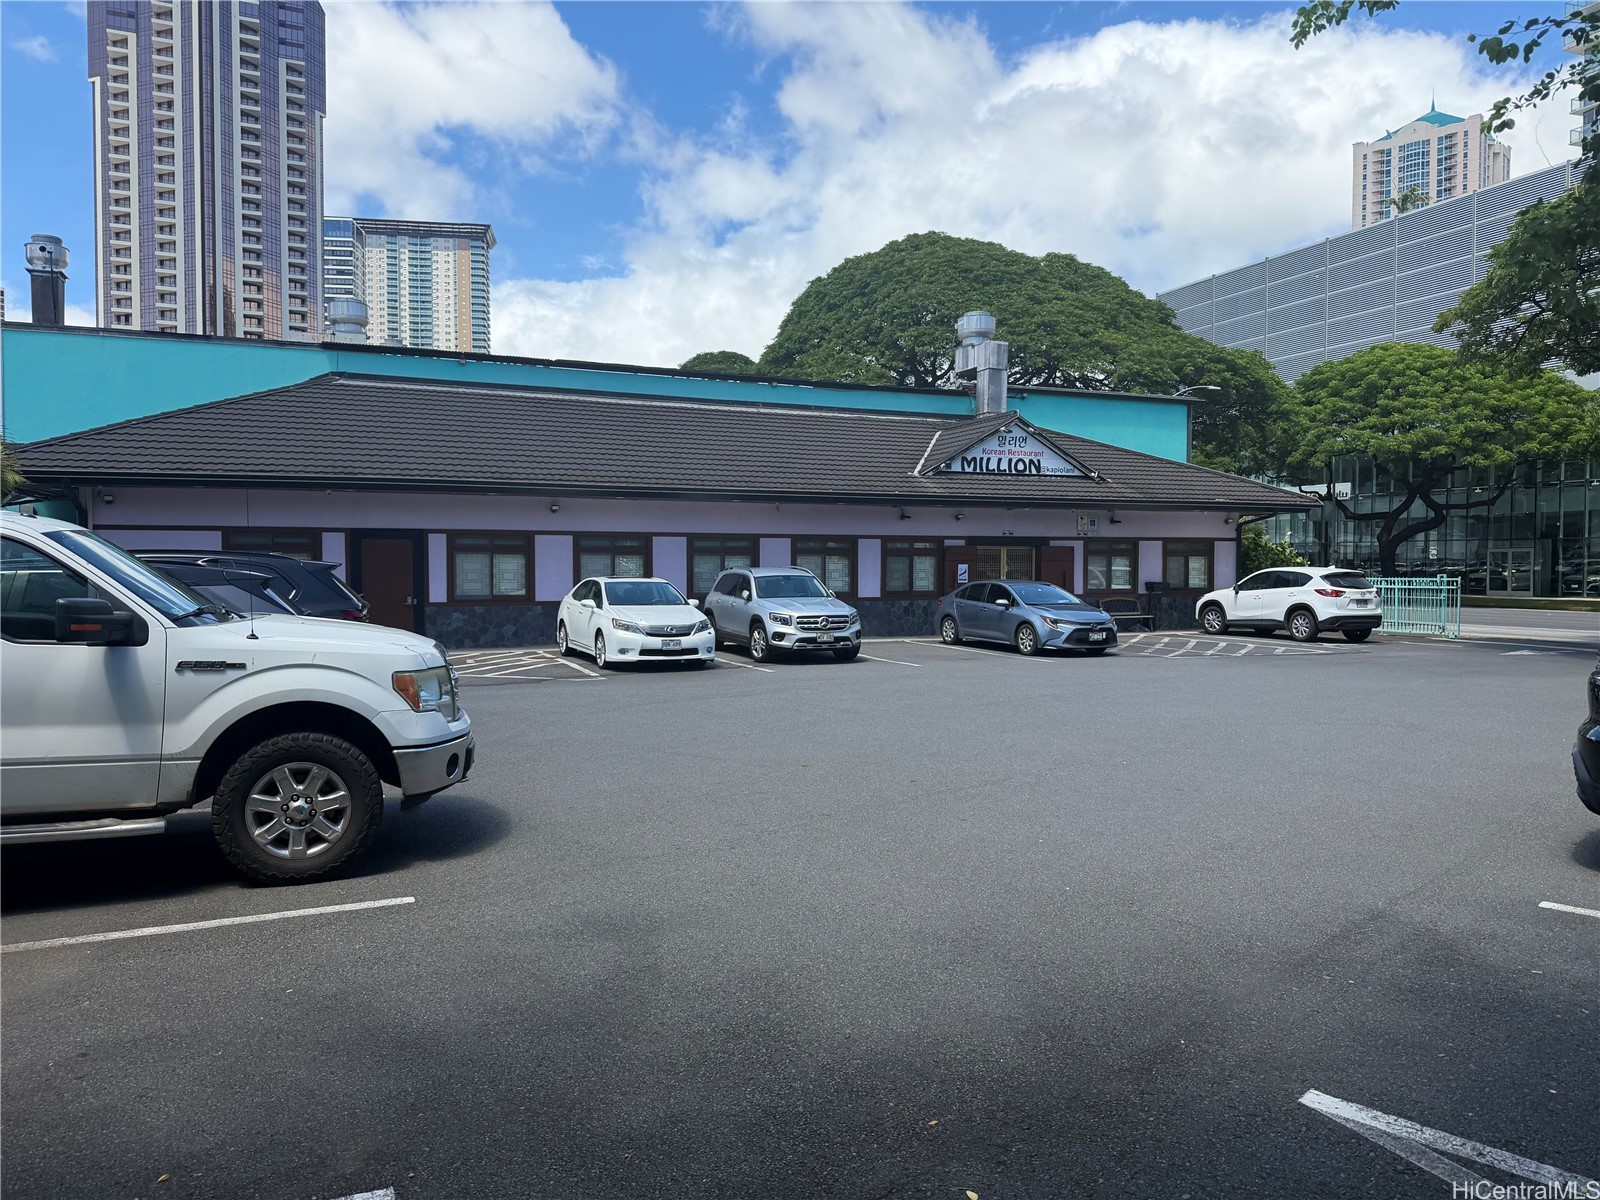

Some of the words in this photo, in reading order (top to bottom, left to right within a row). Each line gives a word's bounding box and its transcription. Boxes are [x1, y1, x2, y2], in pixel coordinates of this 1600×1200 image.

[997, 435, 1028, 448] 밀리언
[982, 448, 1006, 456] Korean
[1007, 449, 1044, 457] Restaurant
[960, 456, 1041, 474] MILLION
